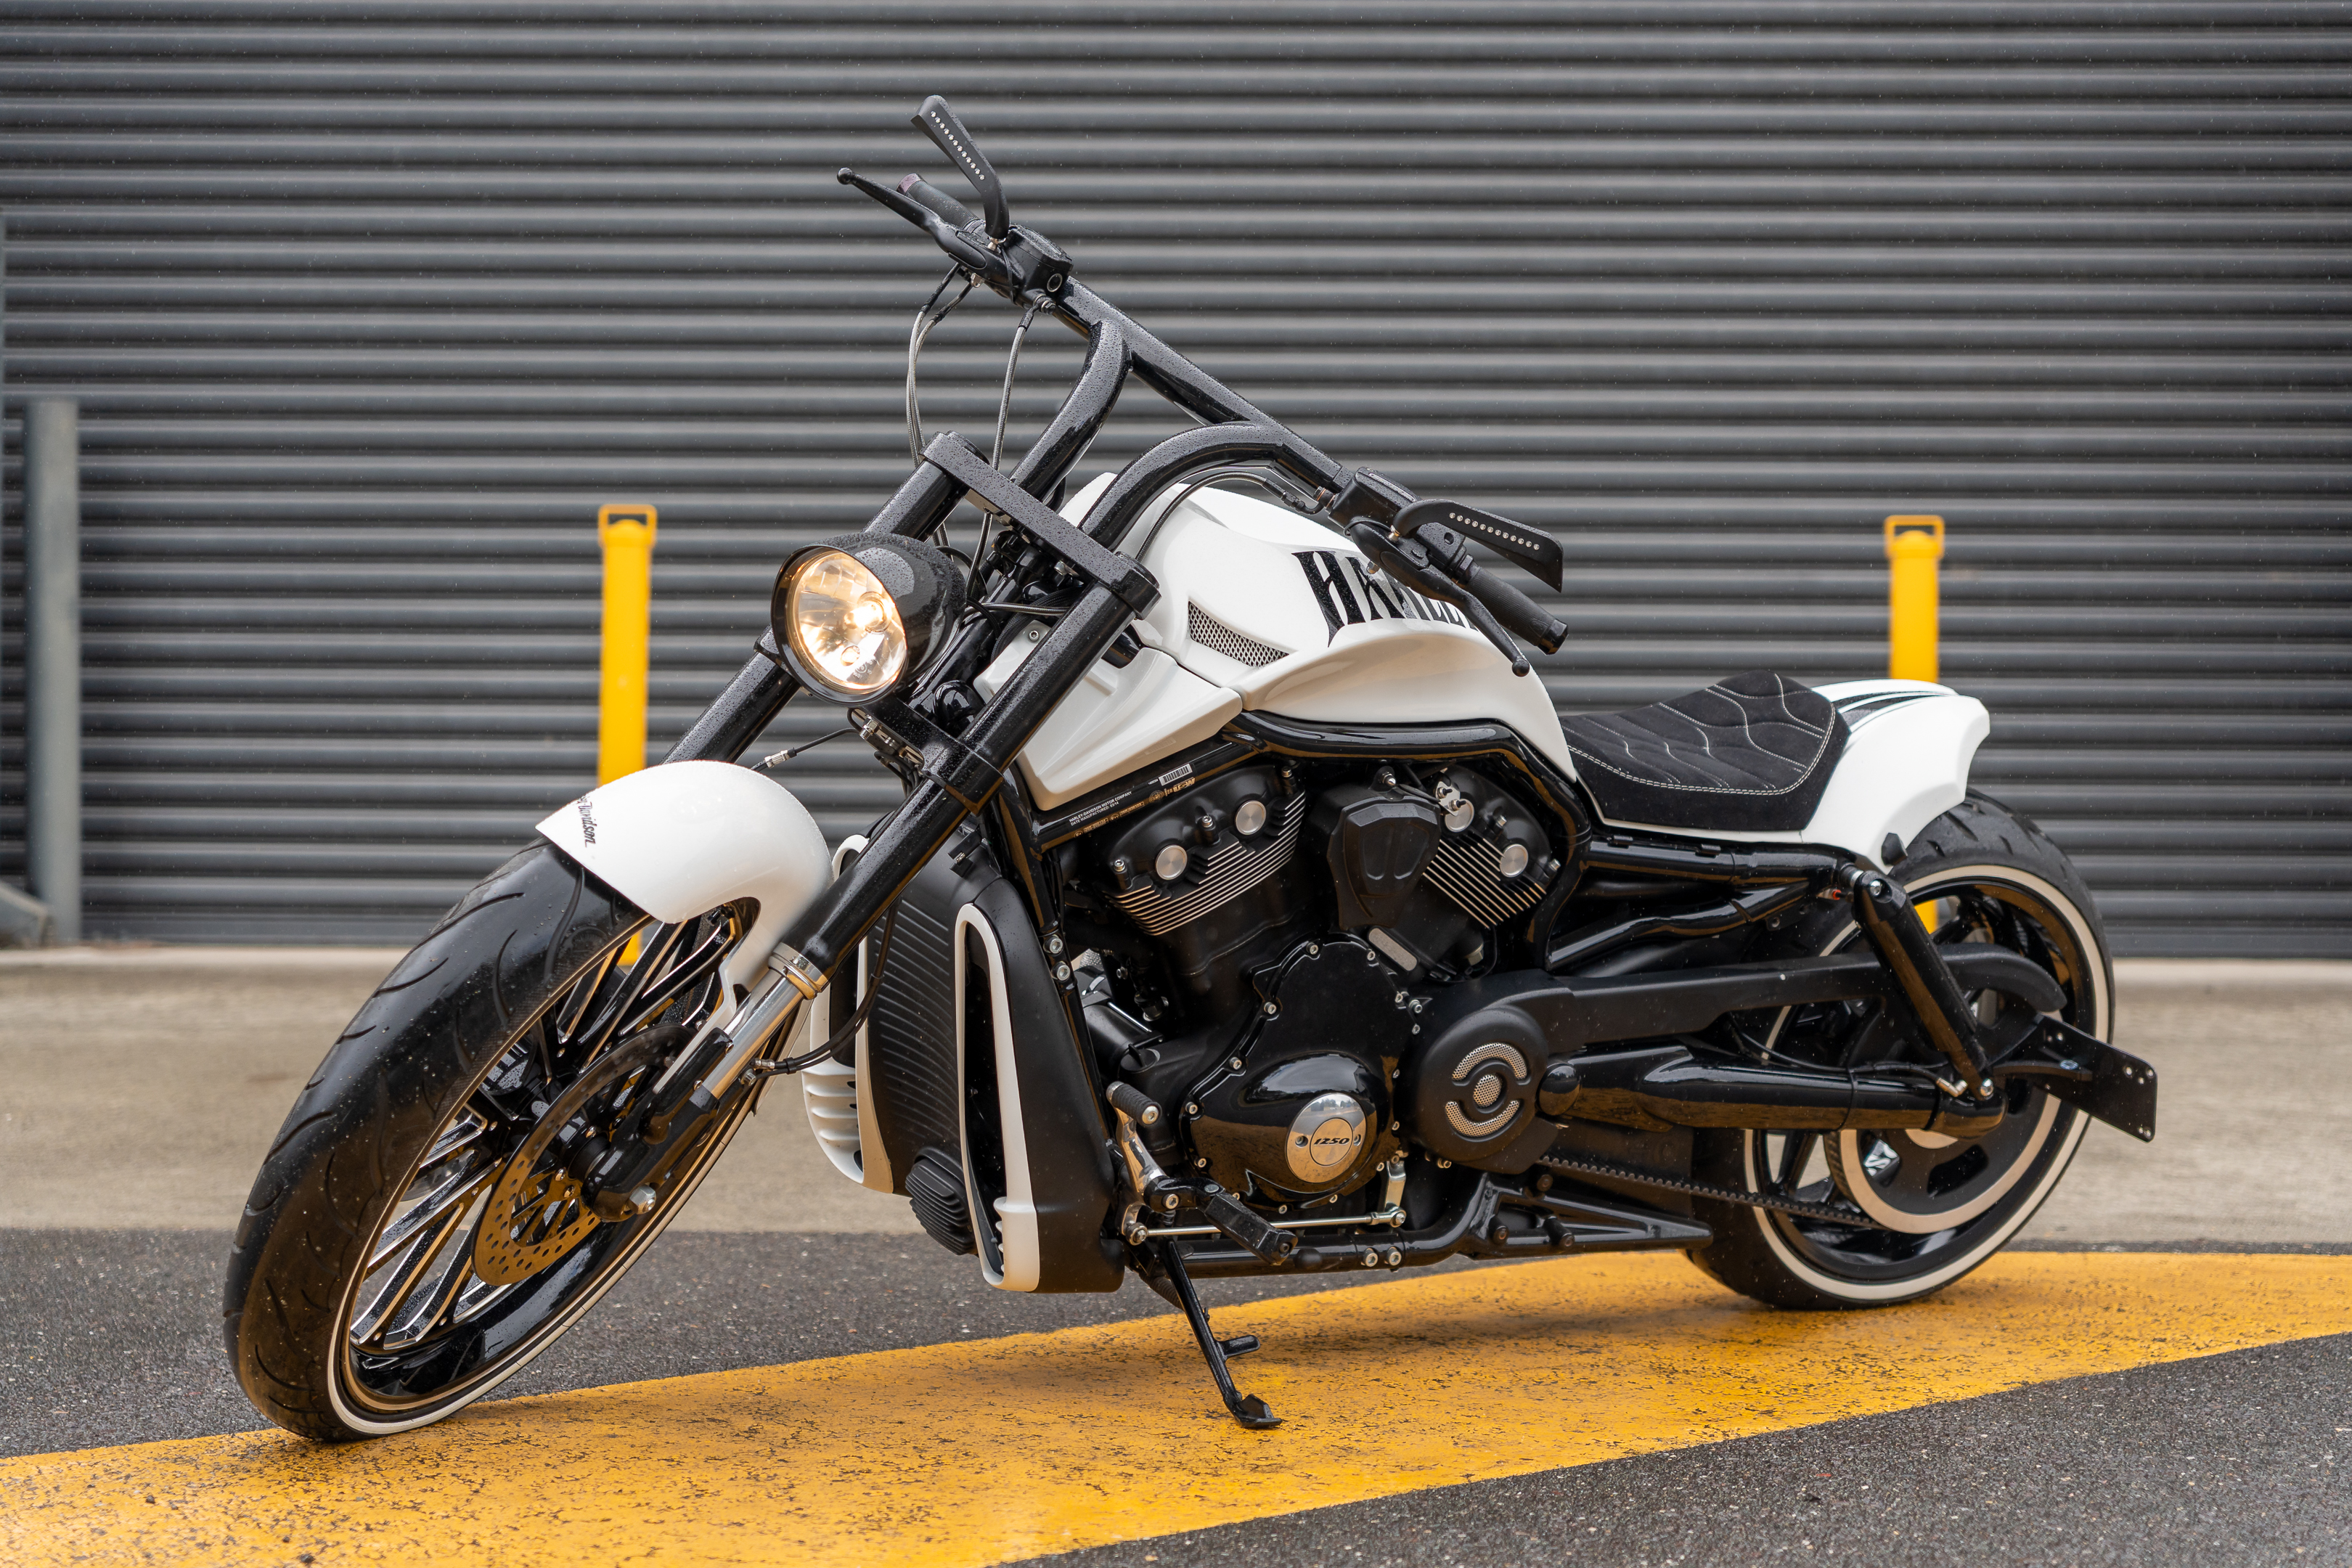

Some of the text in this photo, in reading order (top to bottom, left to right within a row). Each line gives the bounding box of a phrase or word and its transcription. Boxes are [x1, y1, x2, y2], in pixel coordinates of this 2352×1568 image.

[1069, 791, 1132, 822] HARLEY-DAVIDSON MOTOR COMPANY
